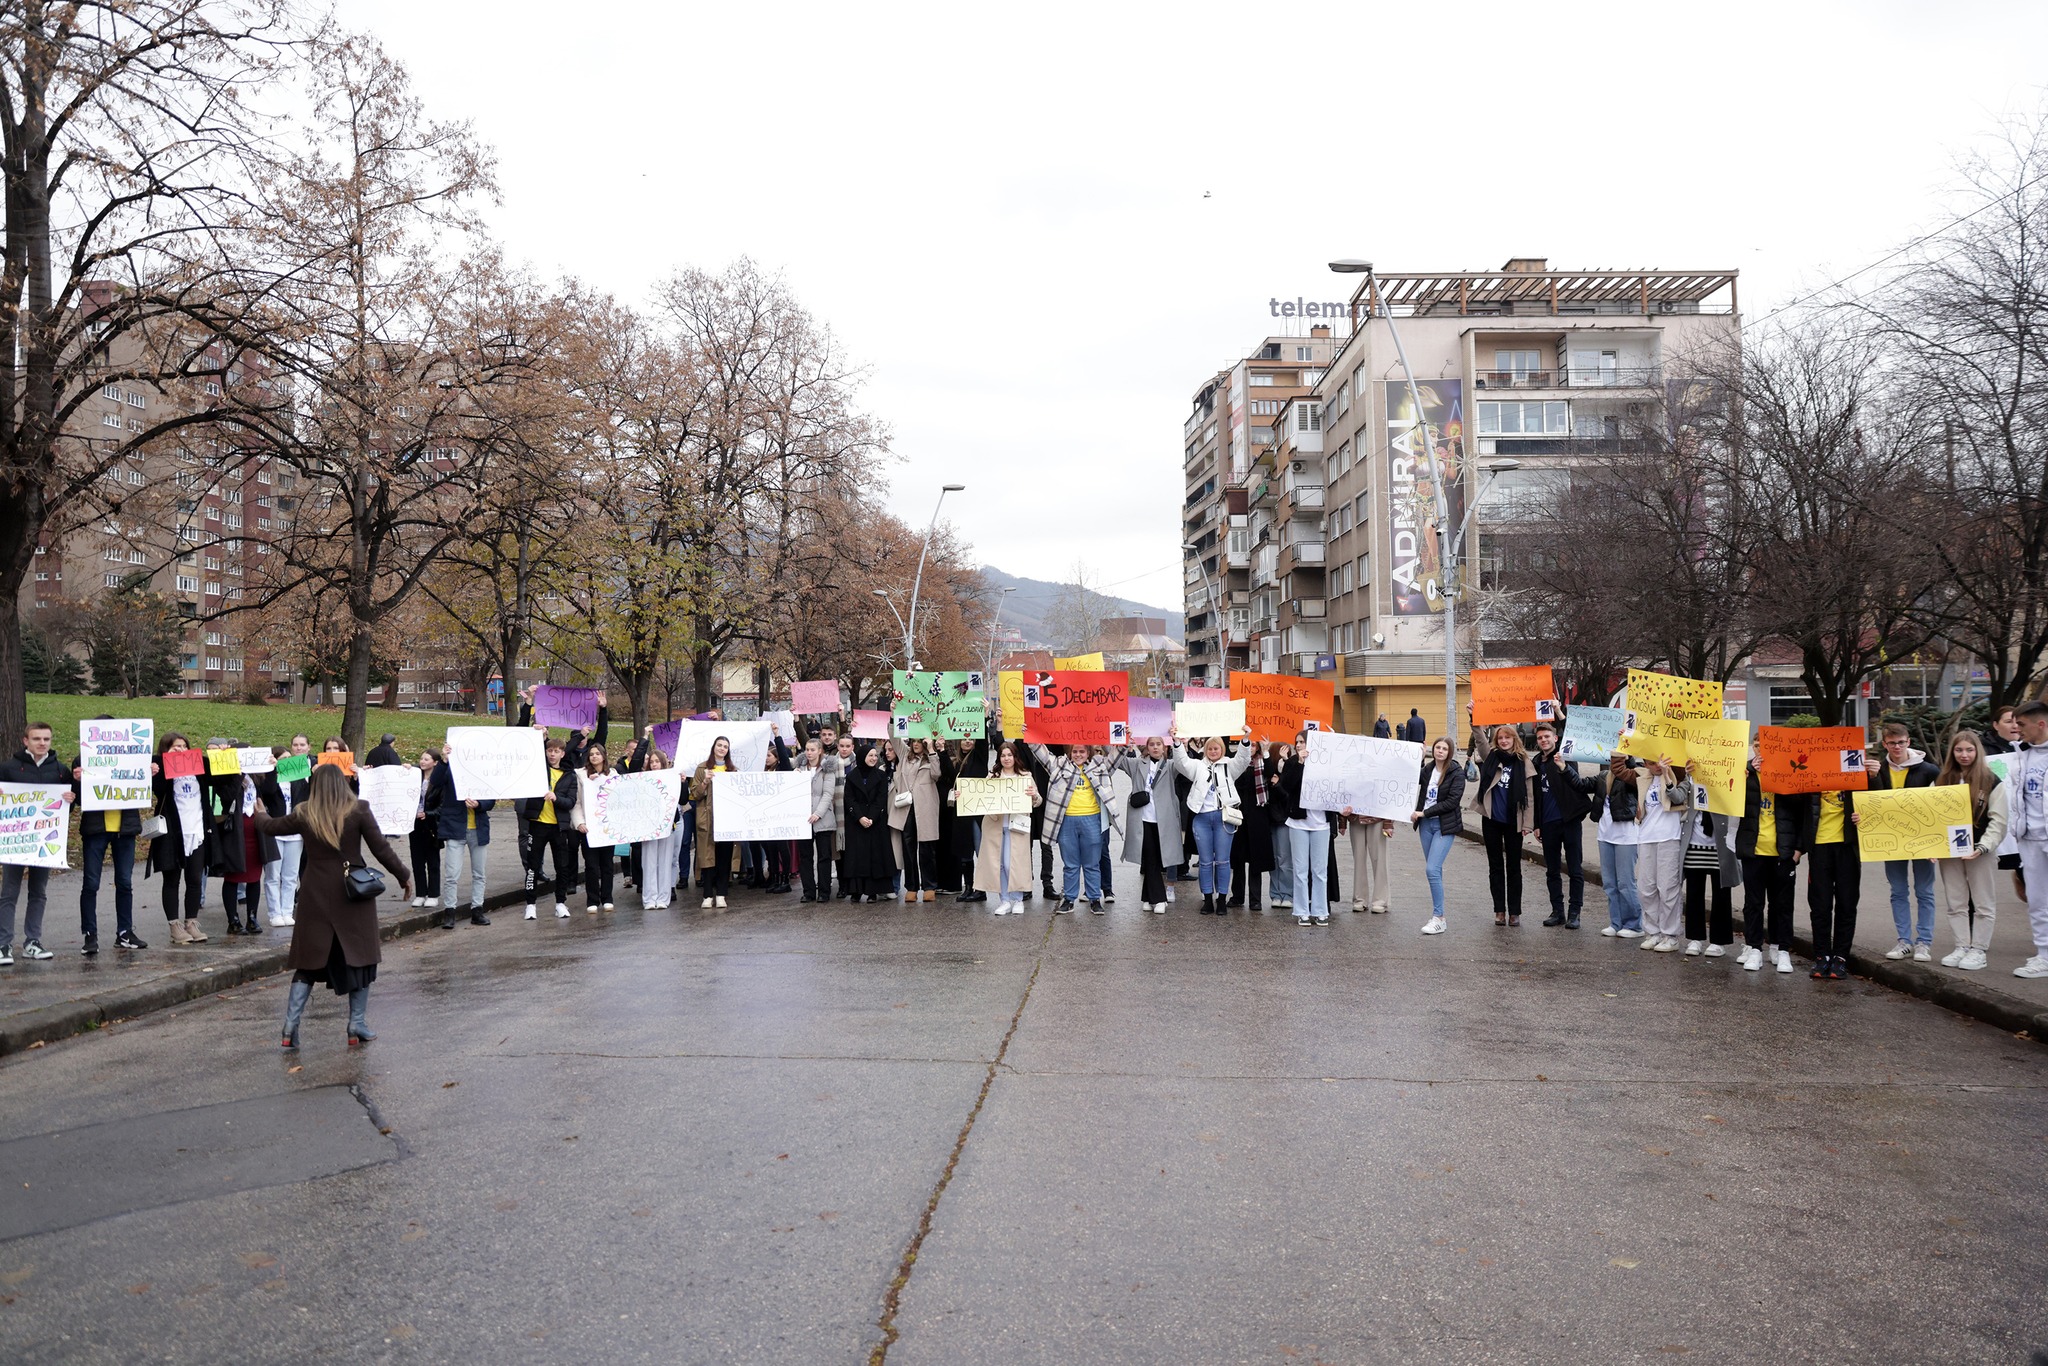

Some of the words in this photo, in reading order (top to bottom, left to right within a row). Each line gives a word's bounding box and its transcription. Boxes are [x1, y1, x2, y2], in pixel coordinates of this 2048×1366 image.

[1388, 404, 1421, 592] ADMIRAL
[1063, 685, 1125, 706] DECEMBAR
[1240, 678, 1284, 696] INSPIRIŠI
[543, 687, 594, 709] STOP
[1246, 701, 1280, 711] NSPIRIŠI
[1046, 727, 1109, 741] volontera
[1763, 731, 1783, 743] Kada
[1310, 748, 1333, 766] OČI
[1336, 736, 1419, 761] ZATVARAJ
[962, 795, 1021, 813] KAZNE
[1379, 792, 1414, 809] SADA
